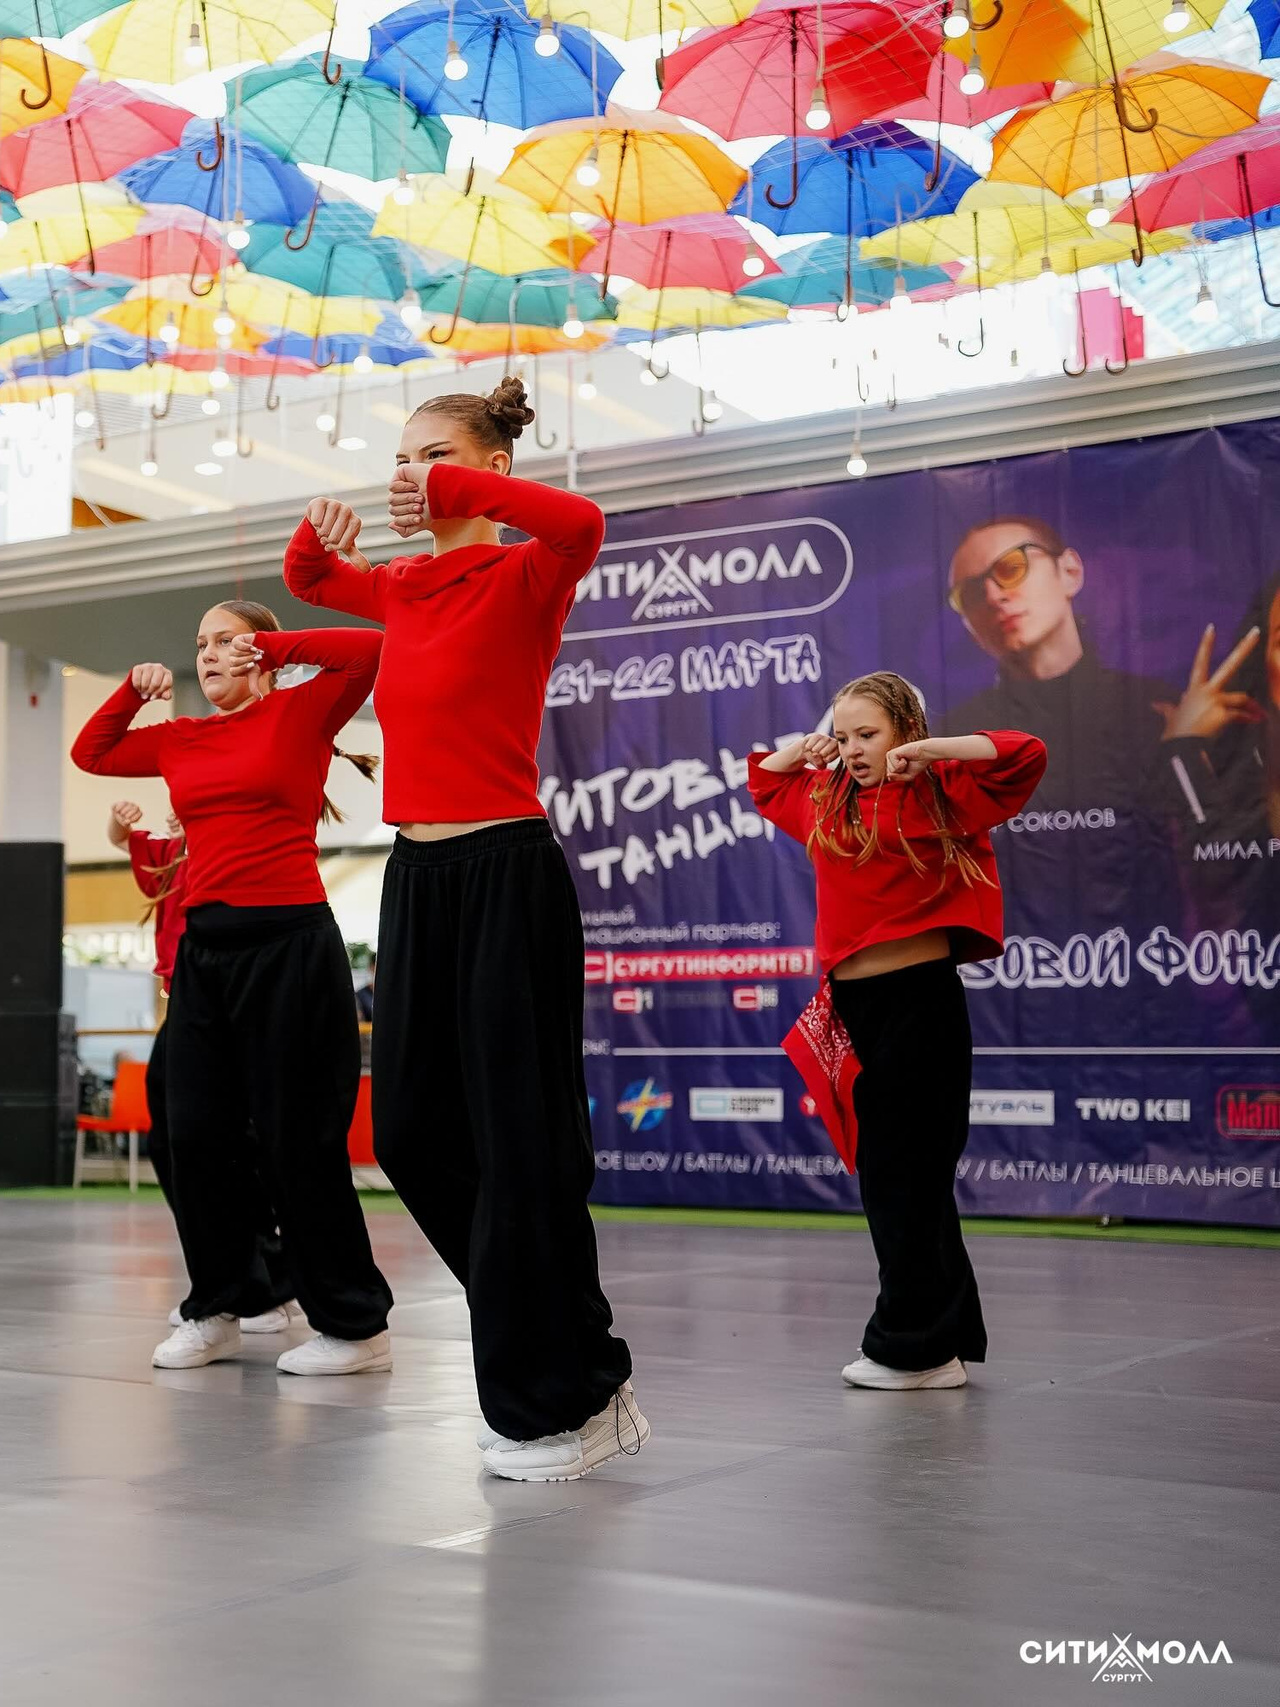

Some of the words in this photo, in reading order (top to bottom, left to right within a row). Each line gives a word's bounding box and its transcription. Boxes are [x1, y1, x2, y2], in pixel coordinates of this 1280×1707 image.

[574, 557, 657, 603] ИТИ
[688, 538, 824, 587] МОЛЛ
[545, 652, 676, 708] 21-22
[679, 633, 821, 694] МАРТА
[1007, 806, 1117, 834] СОКОЛОВ
[1193, 839, 1264, 863] МИЛА
[1075, 1097, 1140, 1121] TWO
[1144, 1098, 1191, 1122] KEI
[989, 1158, 1068, 1183] БАТТЛЫ
[1087, 1162, 1265, 1189] ТАНЦЕВАЛЬНОЕ
